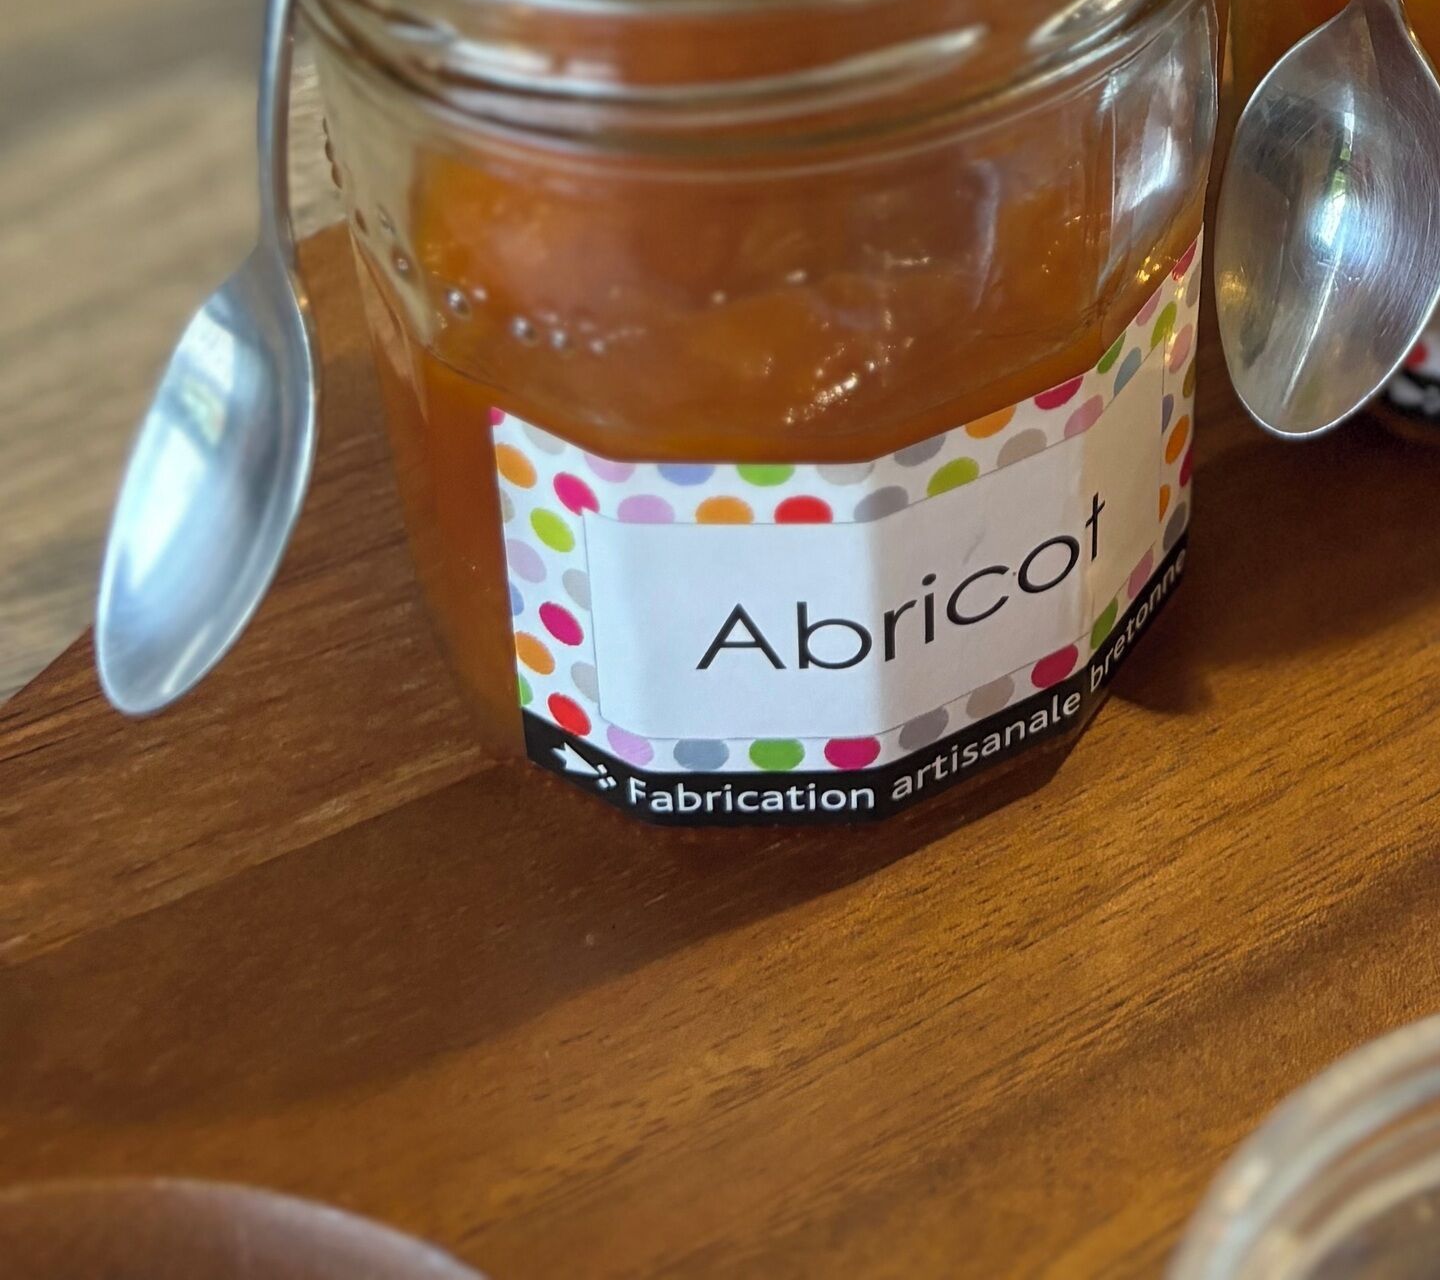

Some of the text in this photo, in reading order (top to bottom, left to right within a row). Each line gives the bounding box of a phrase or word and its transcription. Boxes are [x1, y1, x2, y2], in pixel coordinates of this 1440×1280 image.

[627, 547, 1187, 816] Fabrication artisanale bretonne
[695, 491, 1107, 672] Abricot
